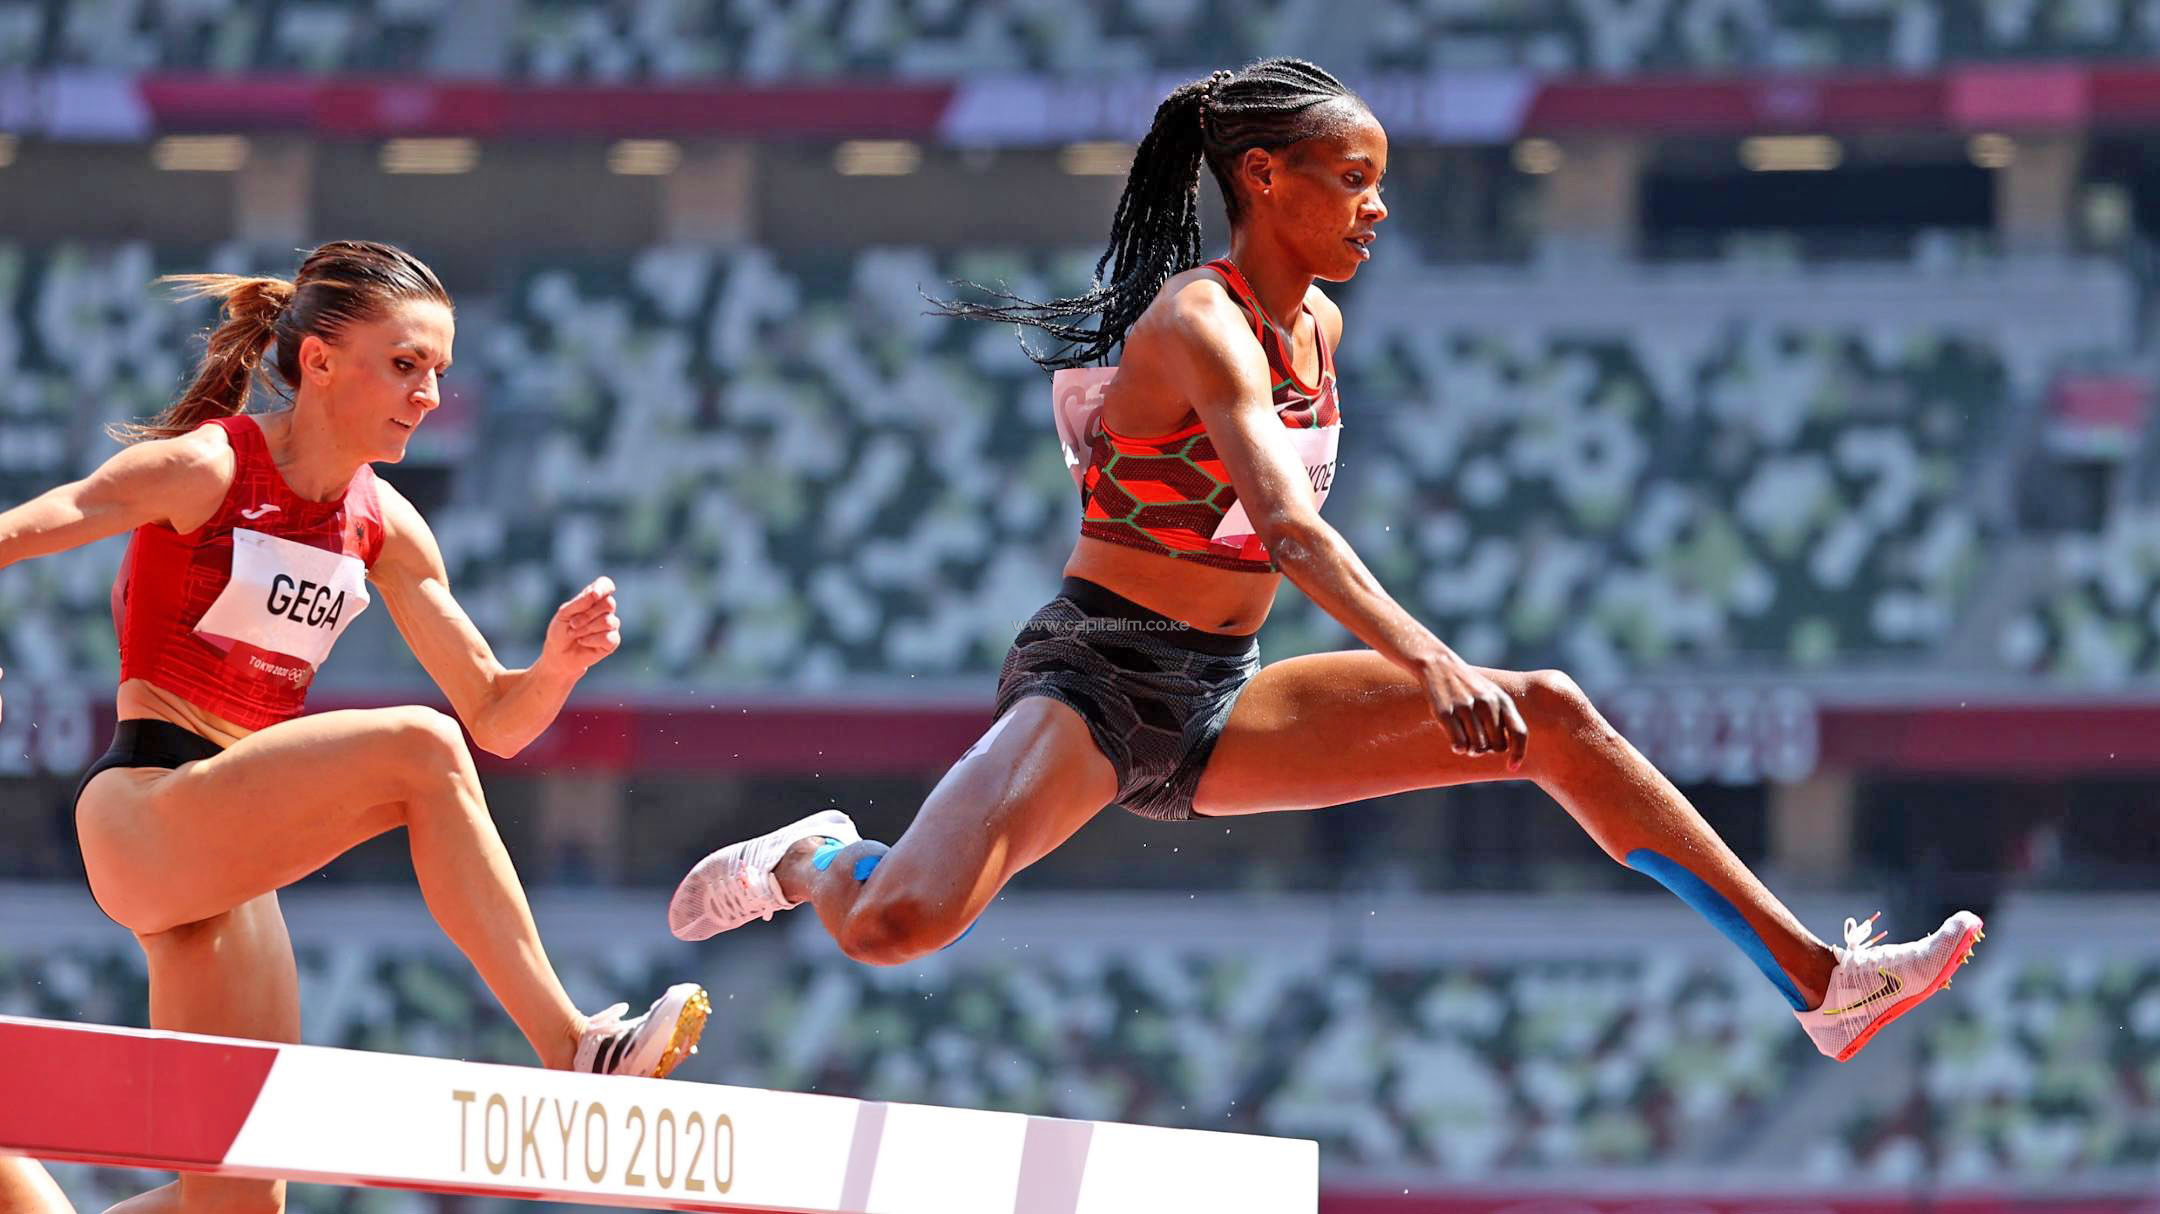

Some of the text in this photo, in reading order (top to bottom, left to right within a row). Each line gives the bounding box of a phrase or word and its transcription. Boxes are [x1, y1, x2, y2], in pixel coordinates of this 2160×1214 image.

[1305, 462, 1334, 493] KOE
[266, 573, 346, 631] GEGA
[452, 1089, 735, 1195] TOKYO 2020
